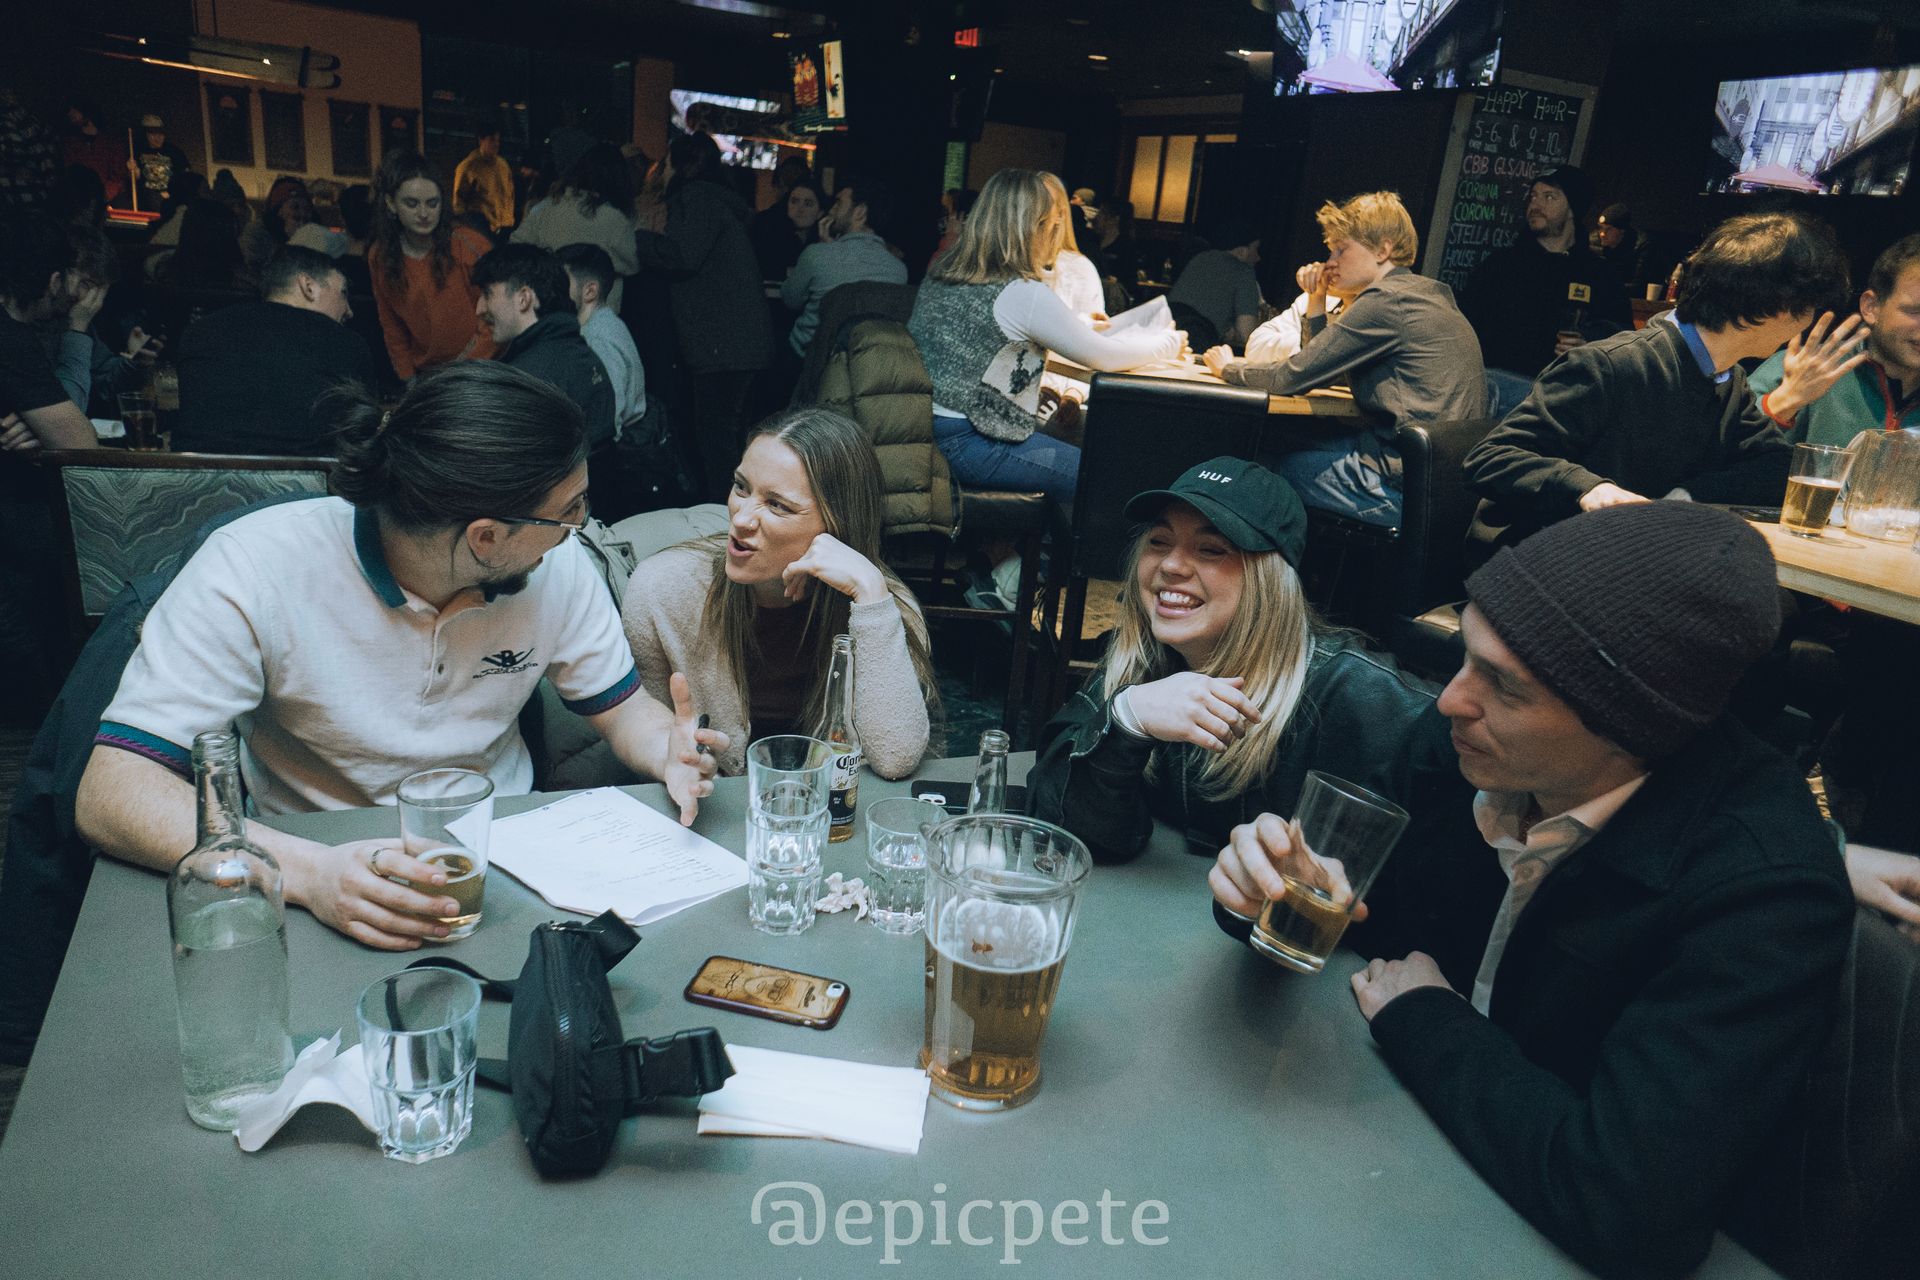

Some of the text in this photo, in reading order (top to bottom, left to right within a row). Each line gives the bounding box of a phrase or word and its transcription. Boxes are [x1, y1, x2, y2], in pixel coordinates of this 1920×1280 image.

[1464, 155, 1490, 175] CBB
[1459, 180, 1499, 201] CORONA
[1455, 202, 1495, 222] CORONA
[1448, 222, 1490, 246] STELLA
[1197, 470, 1233, 484] HUF
